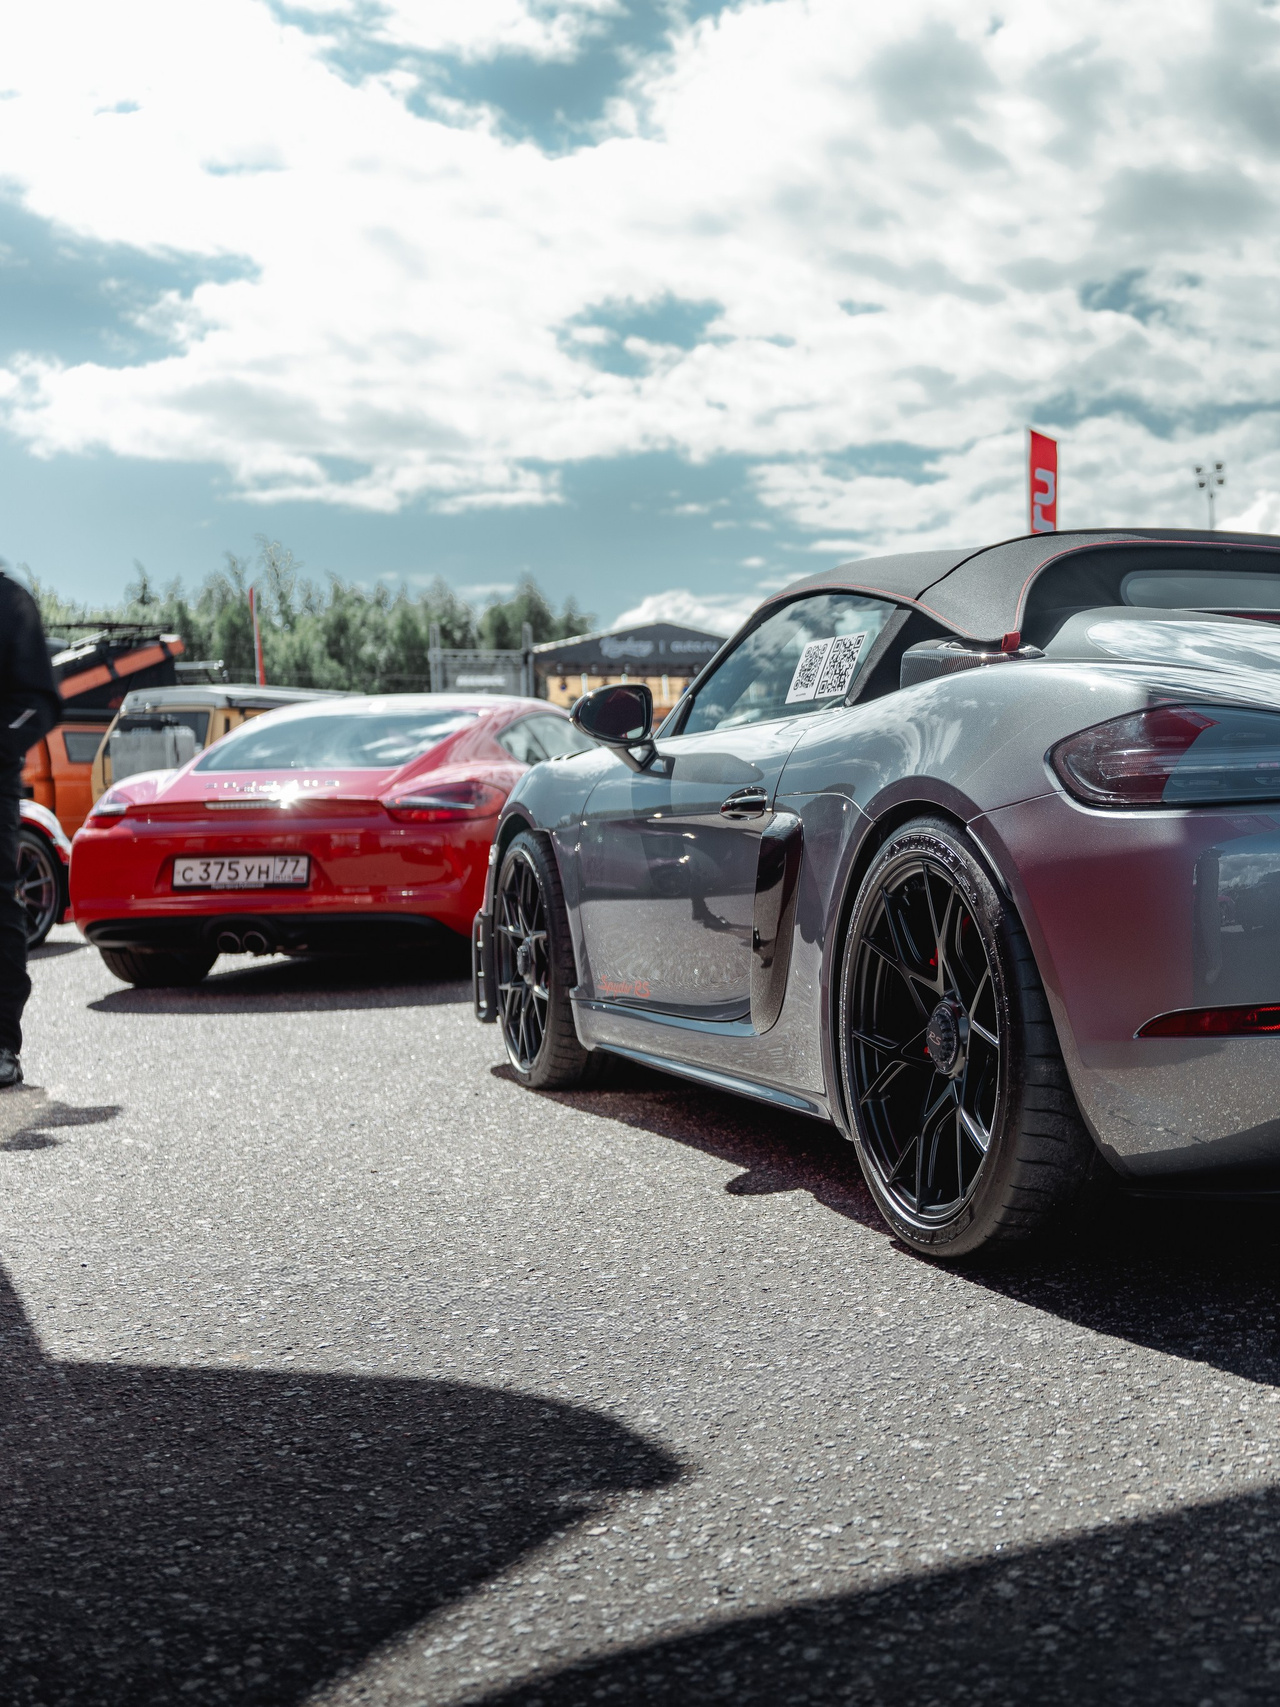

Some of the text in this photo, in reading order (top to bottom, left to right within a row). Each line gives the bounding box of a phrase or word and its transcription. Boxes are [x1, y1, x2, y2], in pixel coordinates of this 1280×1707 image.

[181, 857, 300, 882] С375УН 77
[598, 975, 651, 999] Spyder RS
